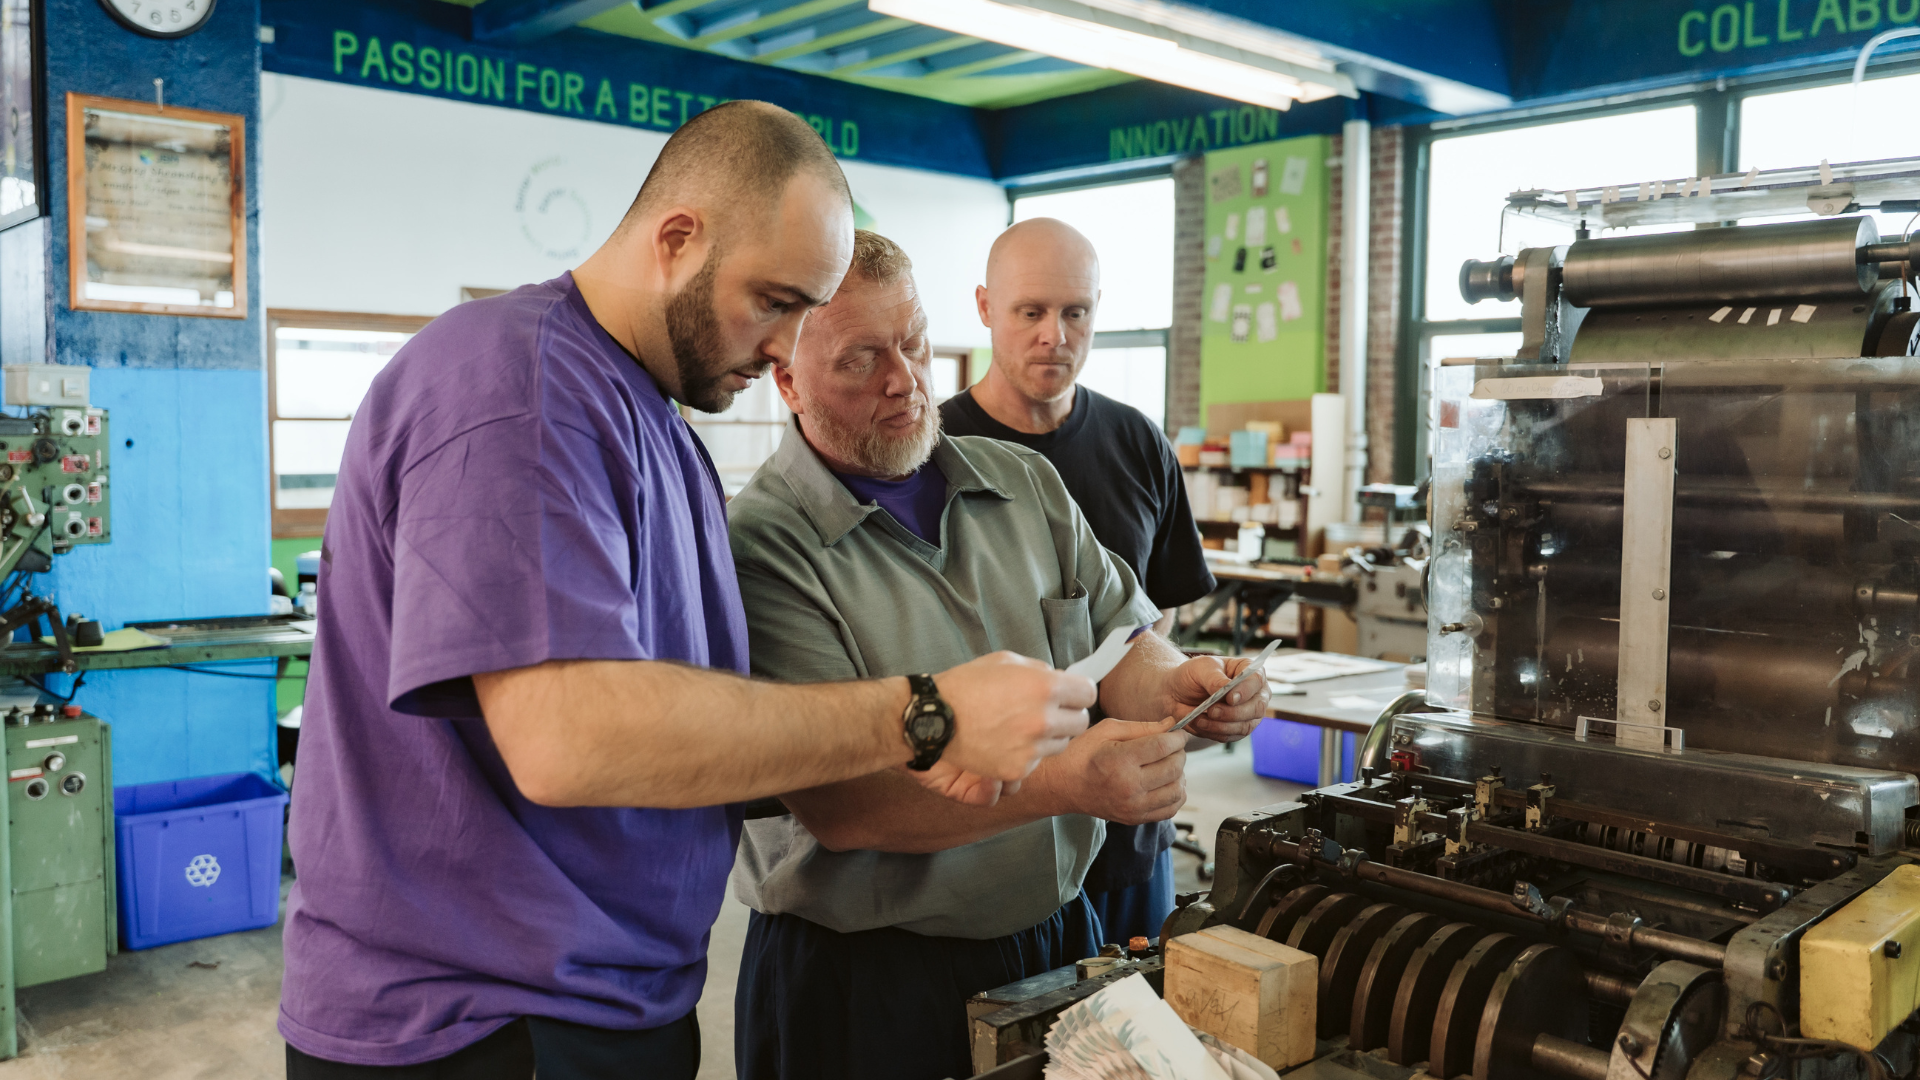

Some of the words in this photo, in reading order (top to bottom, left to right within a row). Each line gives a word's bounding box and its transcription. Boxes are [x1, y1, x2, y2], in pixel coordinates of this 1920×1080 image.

[334, 30, 505, 100] PASSION
[516, 62, 585, 114] FOR
[595, 77, 618, 119] A
[629, 82, 732, 128] BETT
[1109, 106, 1279, 161] INNOVATION
